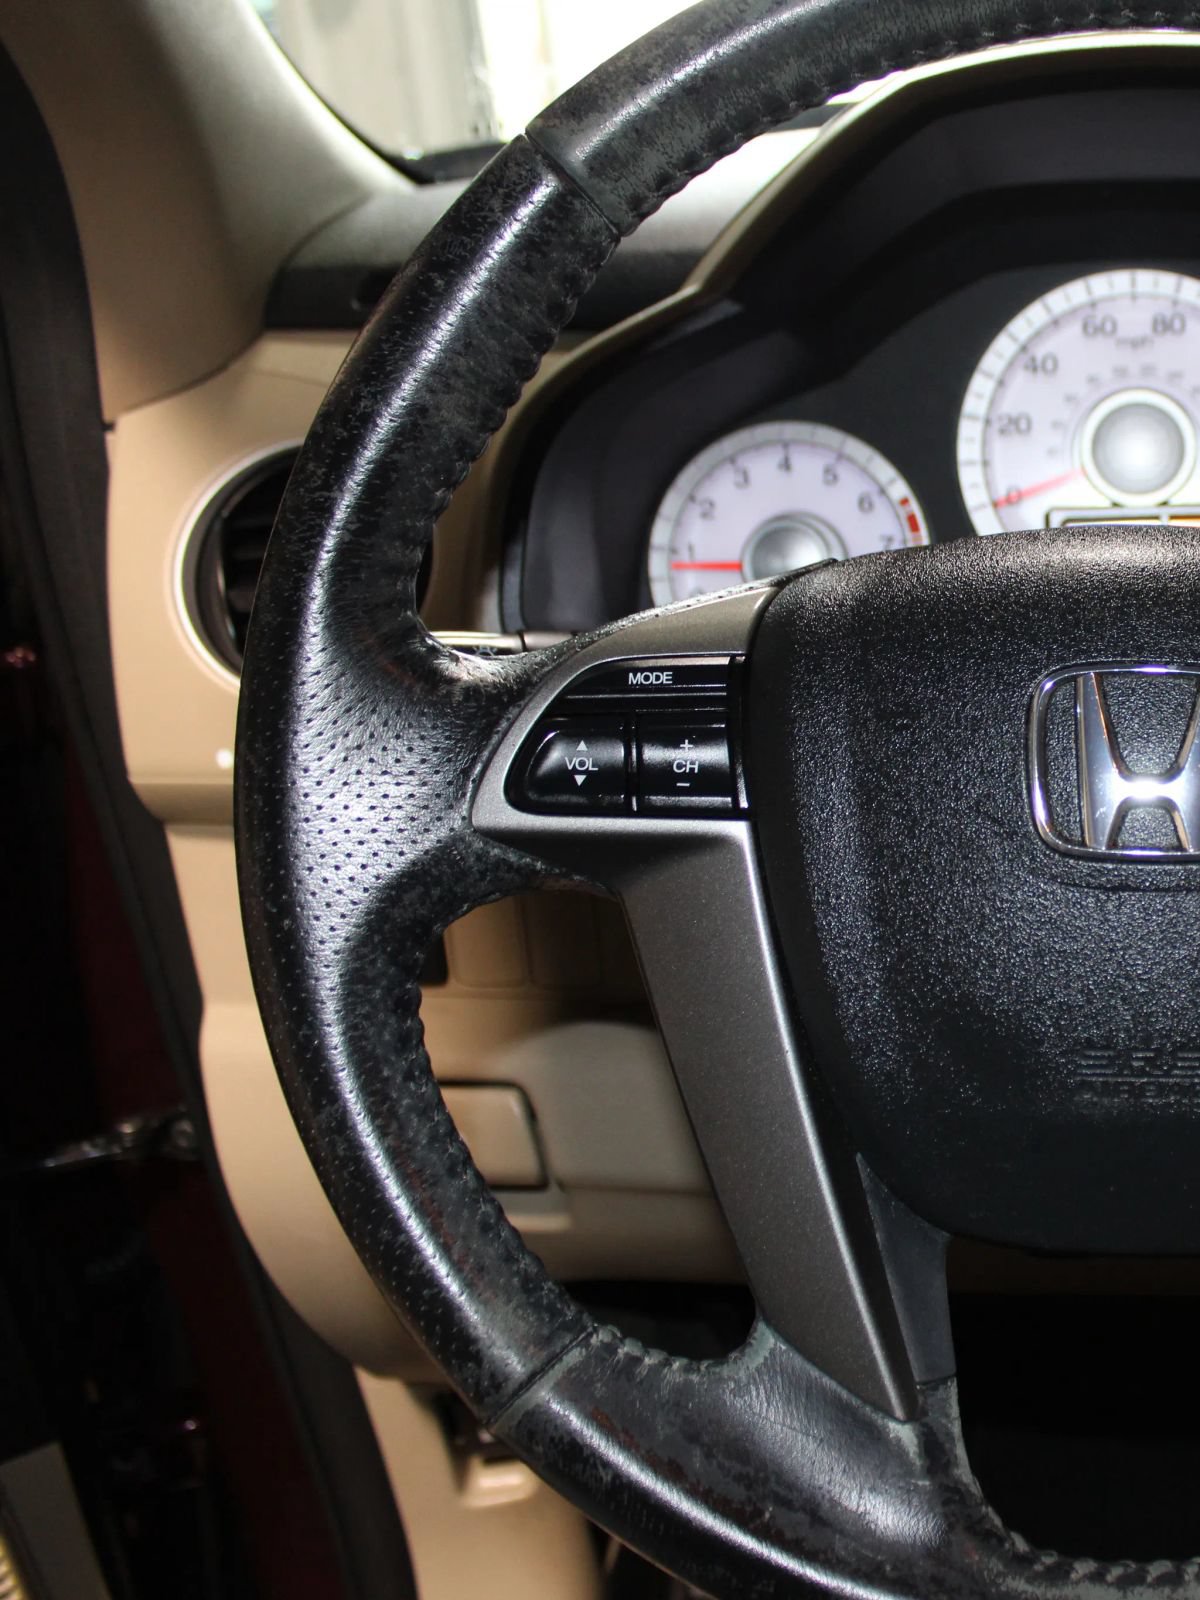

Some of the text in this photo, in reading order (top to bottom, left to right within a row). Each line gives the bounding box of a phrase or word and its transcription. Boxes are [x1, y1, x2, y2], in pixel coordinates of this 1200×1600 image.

[1081, 315, 1117, 336] 60
[1152, 314, 1186, 335] 80
[1023, 353, 1058, 375] 40
[997, 412, 1032, 435] 20
[700, 502, 715, 519] 2
[859, 494, 874, 512] 6
[628, 671, 673, 685] MODE
[565, 756, 599, 772] VOL
[672, 759, 699, 774] CH
